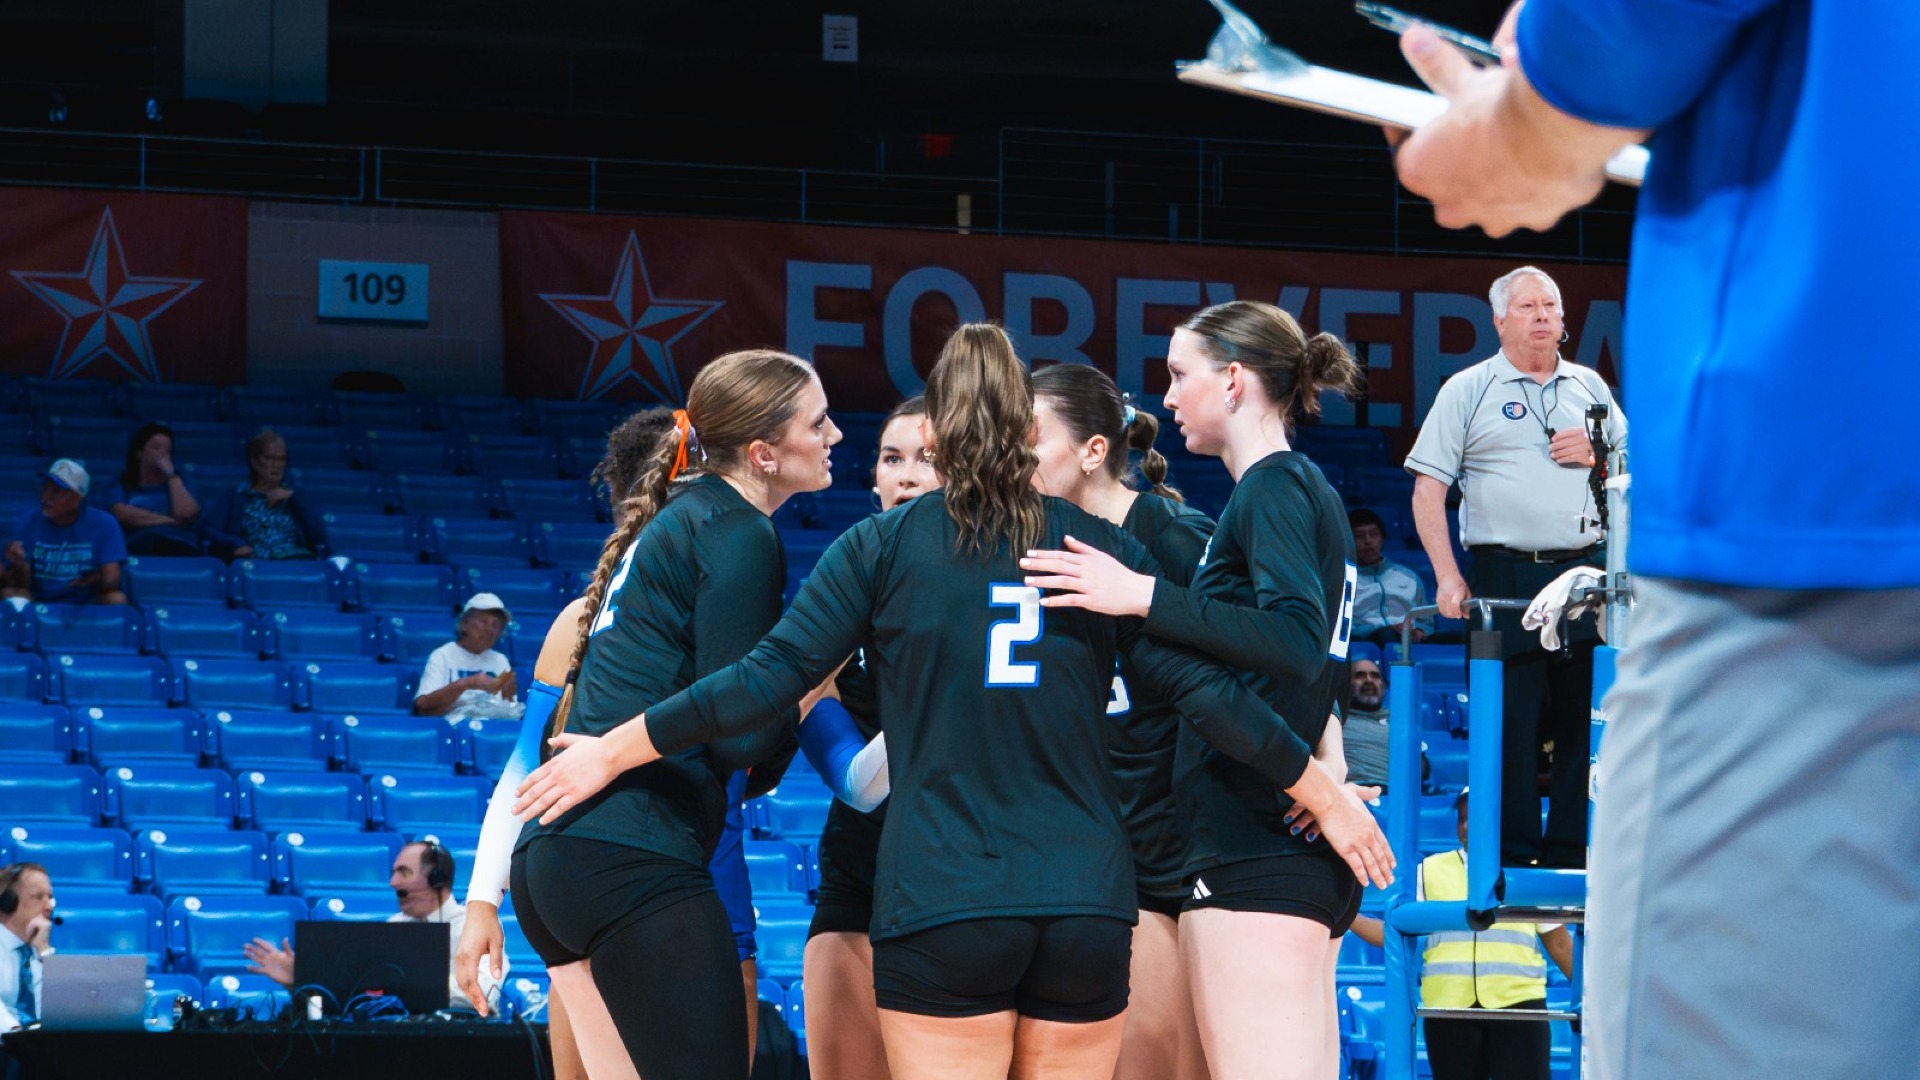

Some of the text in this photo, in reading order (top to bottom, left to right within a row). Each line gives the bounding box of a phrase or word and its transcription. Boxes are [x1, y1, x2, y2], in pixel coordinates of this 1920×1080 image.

[343, 271, 405, 305] 109
[786, 259, 1502, 427] FOREER
[984, 582, 1044, 688] 2
